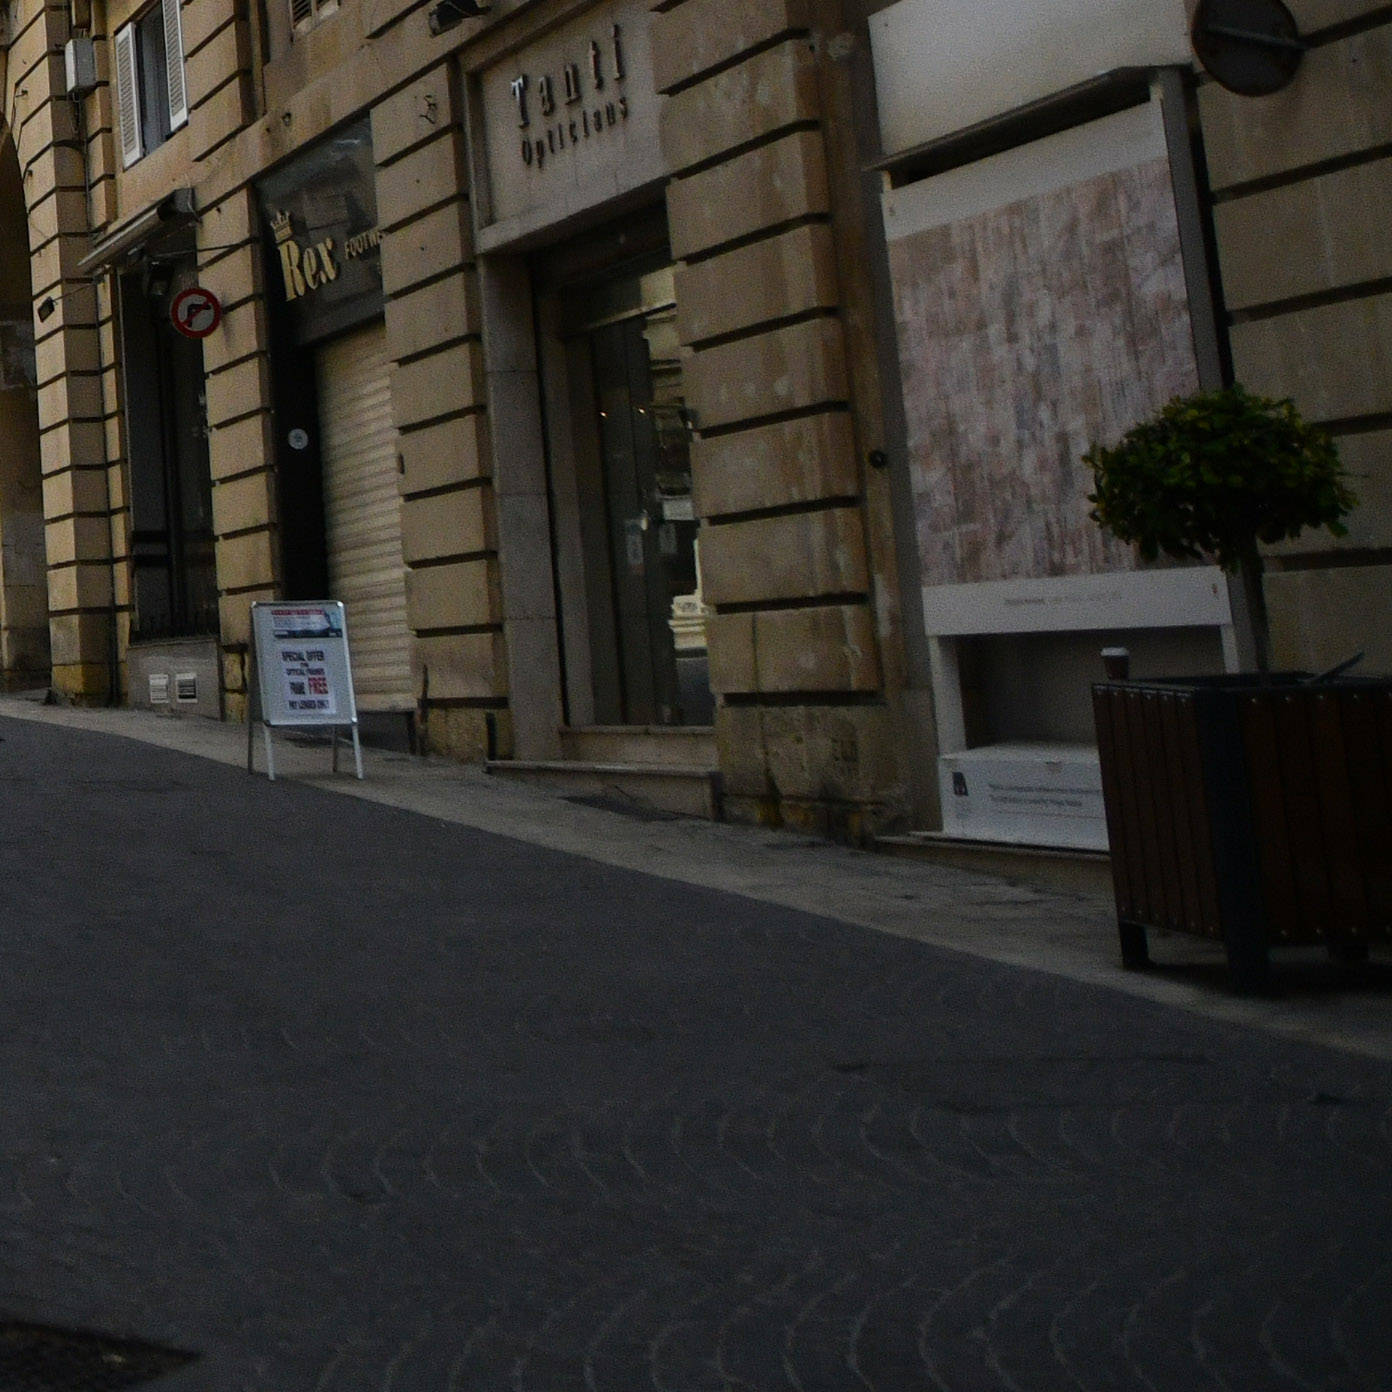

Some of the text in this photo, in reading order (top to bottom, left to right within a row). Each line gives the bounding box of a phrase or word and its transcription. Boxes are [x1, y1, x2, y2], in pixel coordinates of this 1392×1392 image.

[511, 24, 625, 129] Tanti
[521, 96, 628, 169] Opticians
[278, 237, 337, 302] Rex
[308, 677, 329, 695] FREE
